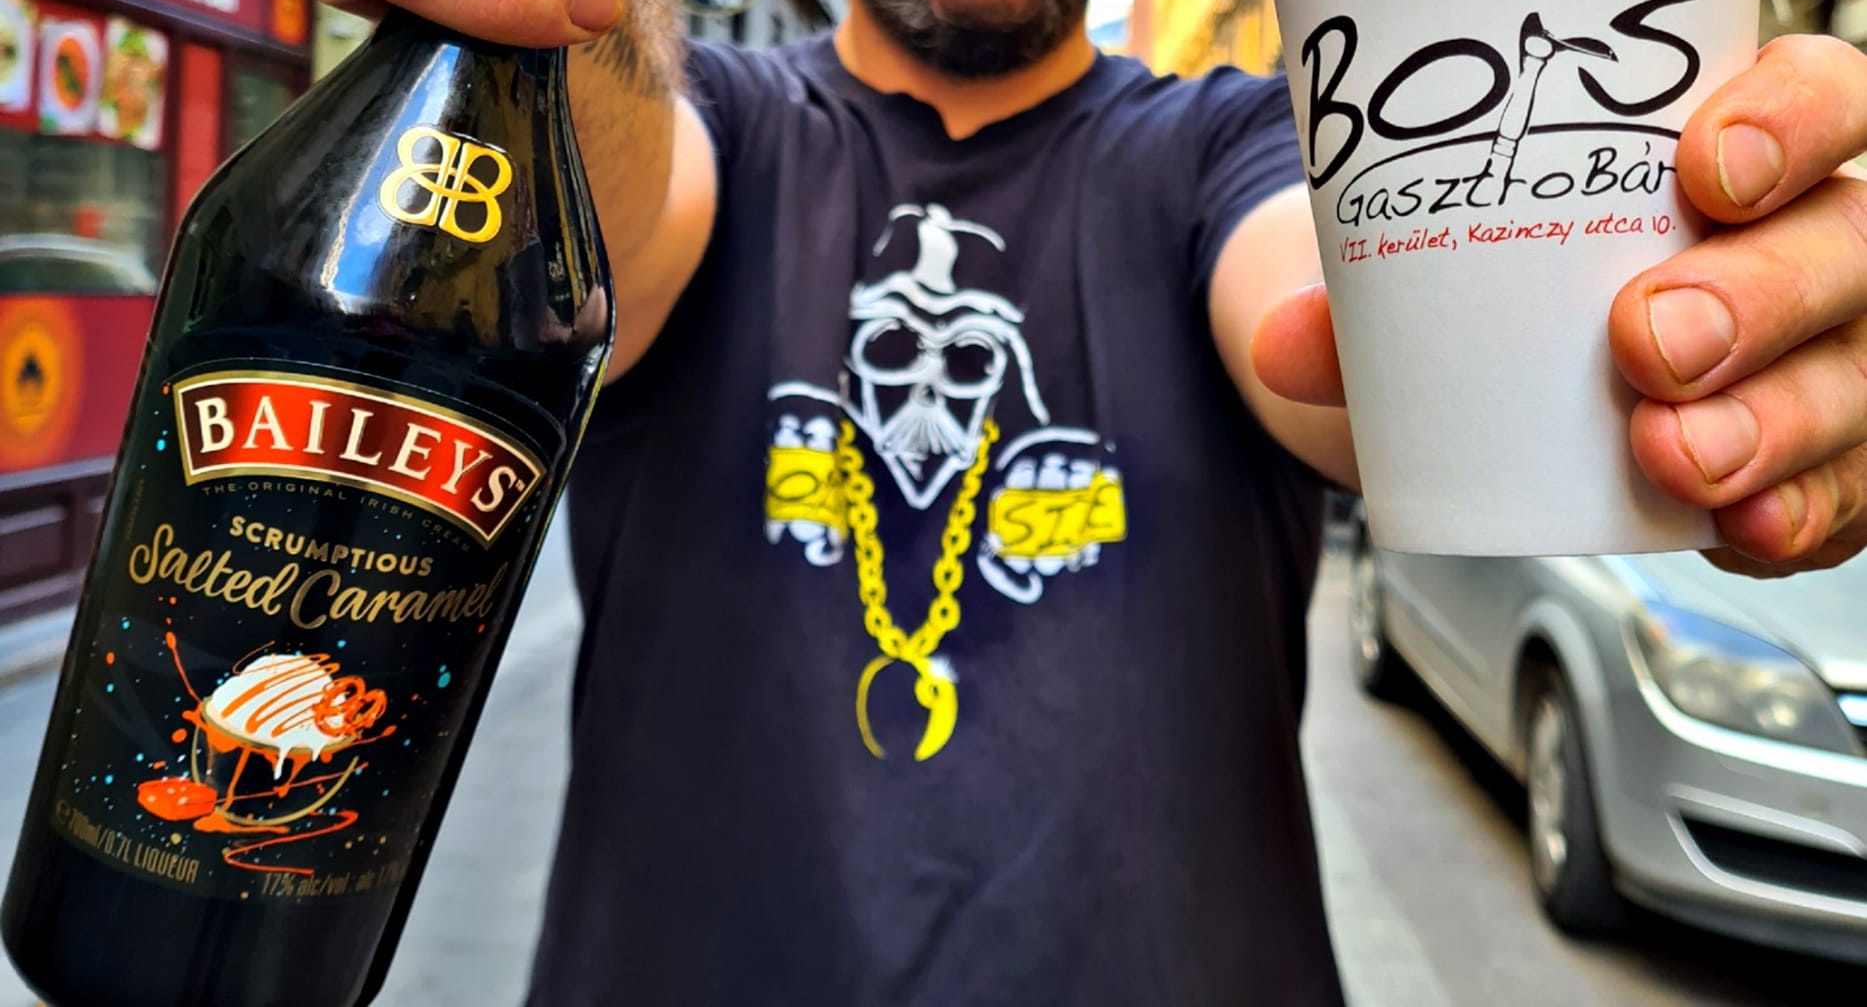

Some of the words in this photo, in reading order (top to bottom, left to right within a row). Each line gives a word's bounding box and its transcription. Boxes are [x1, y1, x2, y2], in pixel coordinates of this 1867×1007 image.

[1340, 238, 1372, 263] VII.
[1377, 227, 1458, 259] kerület,
[1467, 220, 1574, 245] Kazinczy
[1584, 214, 1643, 236] utca
[194, 396, 516, 513] BAILEYS
[201, 482, 238, 496] THE
[247, 481, 348, 502] ORIGINAL
[360, 495, 413, 520] IRISH
[421, 519, 471, 553] CREAM
[229, 515, 435, 577] SCRUMPTIOUS
[129, 523, 299, 616] Salted
[289, 561, 507, 630] Caramel
